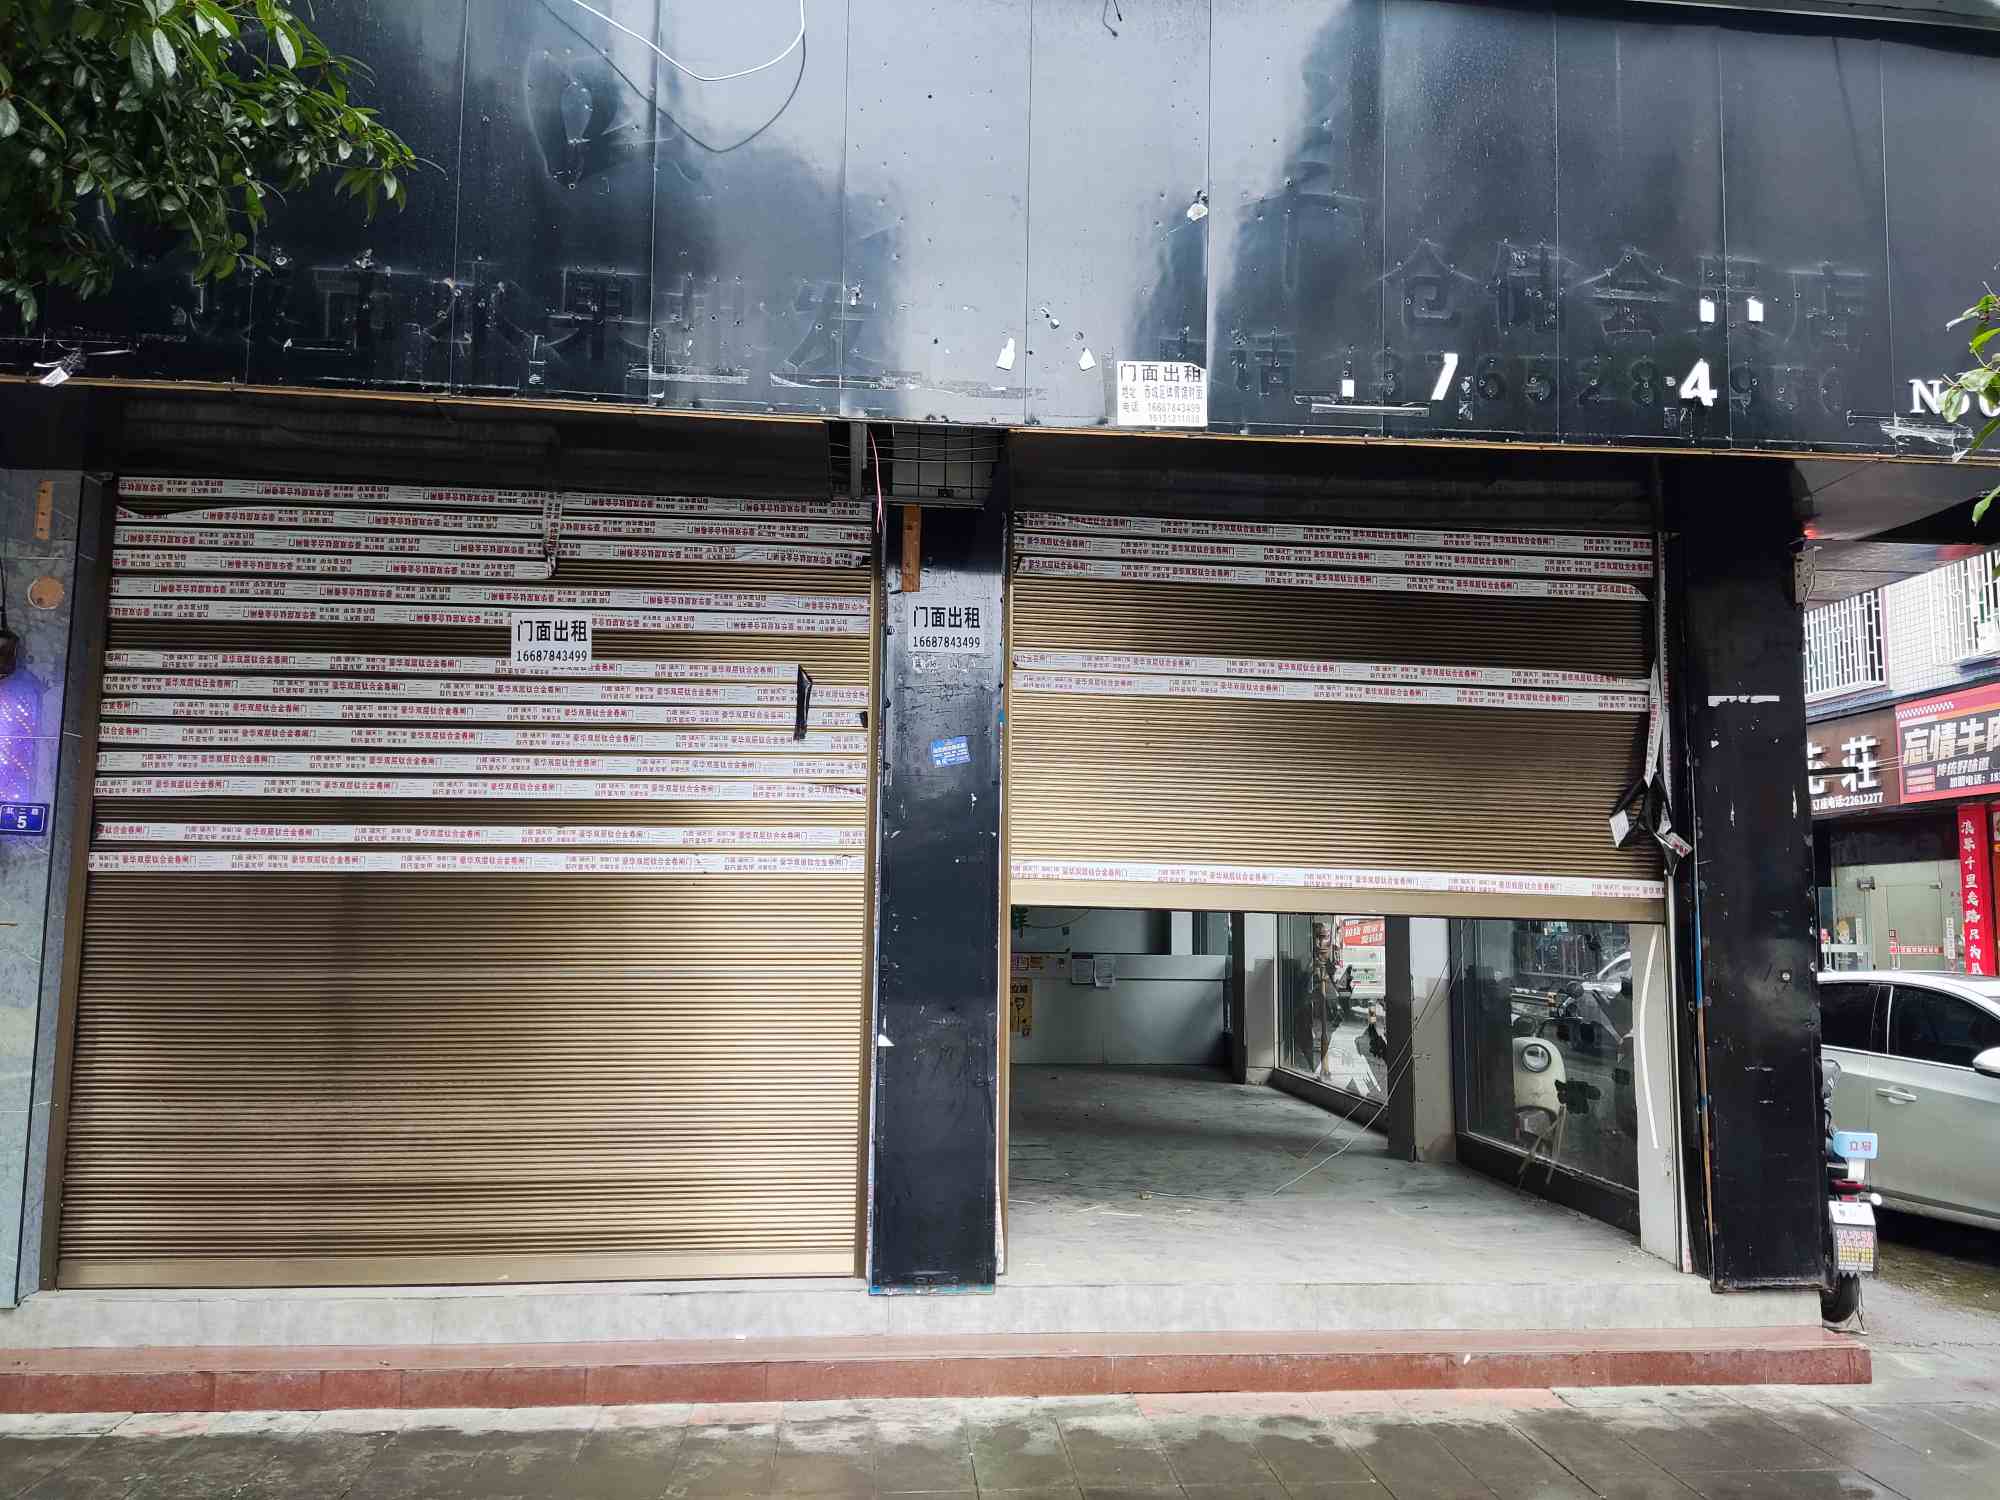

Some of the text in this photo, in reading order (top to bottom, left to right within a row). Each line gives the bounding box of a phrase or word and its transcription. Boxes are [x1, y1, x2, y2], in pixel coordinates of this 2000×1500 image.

[1121, 363, 1201, 383] 门面出租
[913, 606, 981, 629] 门面出租
[517, 620, 588, 642] 门面出租
[913, 636, 981, 648] 16687843499
[516, 650, 588, 662] 16687843499
[17, 815, 28, 829] 5
